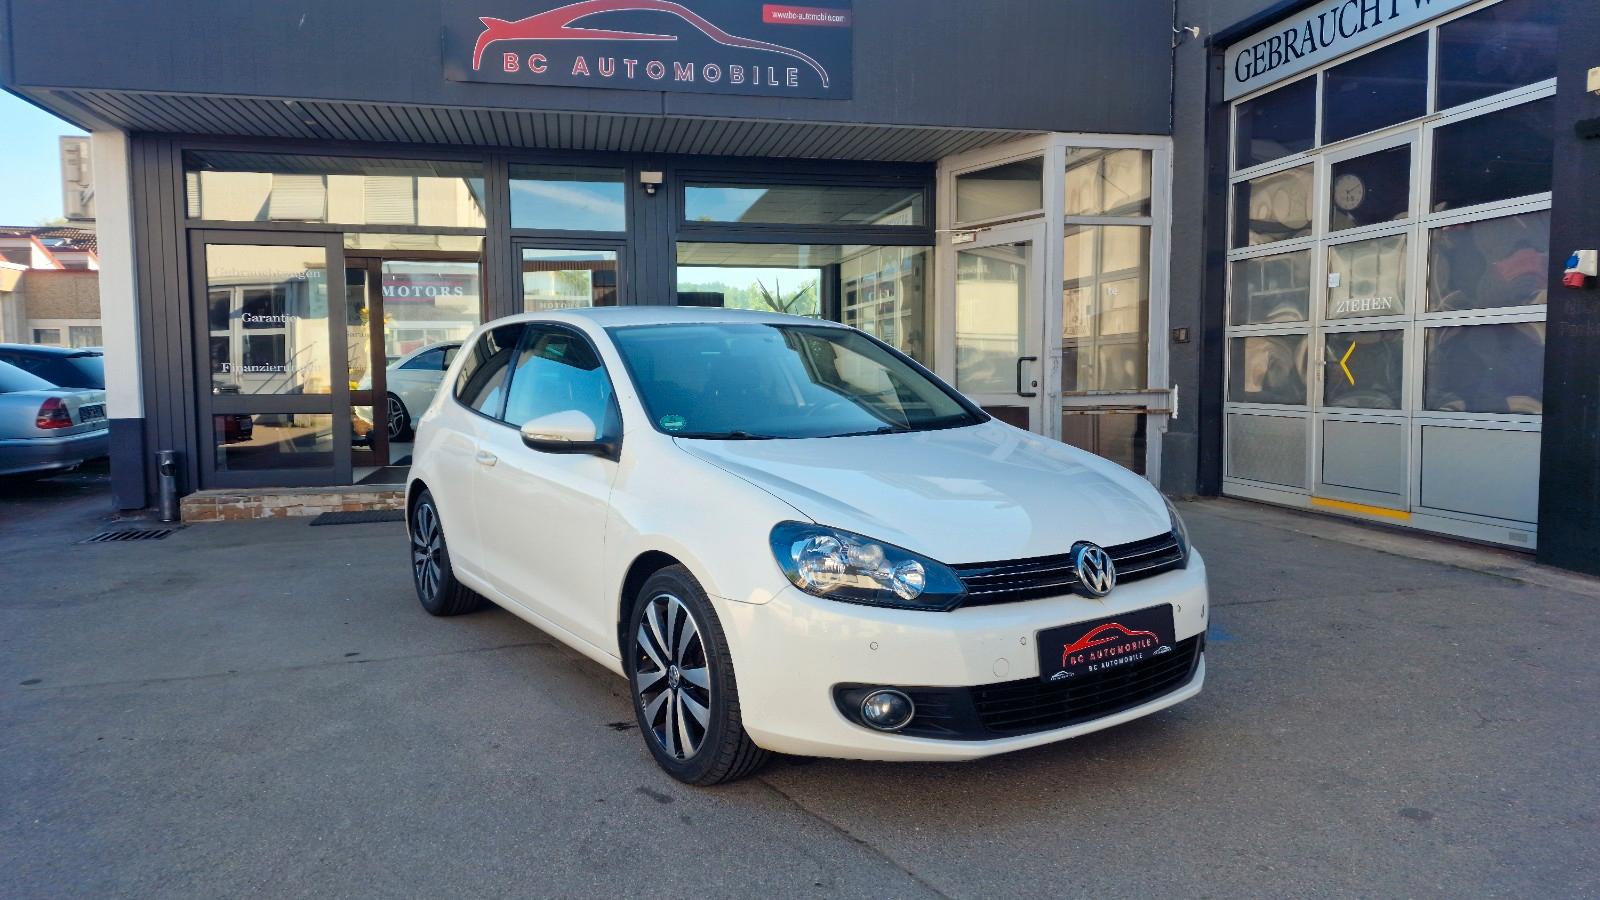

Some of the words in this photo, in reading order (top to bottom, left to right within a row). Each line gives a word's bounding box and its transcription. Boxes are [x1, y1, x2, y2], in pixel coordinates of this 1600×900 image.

[1234, 0, 1431, 83] GEBRAUCH
[503, 52, 548, 74] BC
[572, 56, 799, 88] AUTOMOBILE
[382, 285, 464, 297] MOTORS
[1336, 296, 1393, 313] ZIEHEN
[1070, 655, 1084, 666] BC
[1090, 638, 1151, 660] AUTOMOBILE
[1088, 664, 1098, 672] BC
[1101, 653, 1144, 669] AUTOMOBILE
